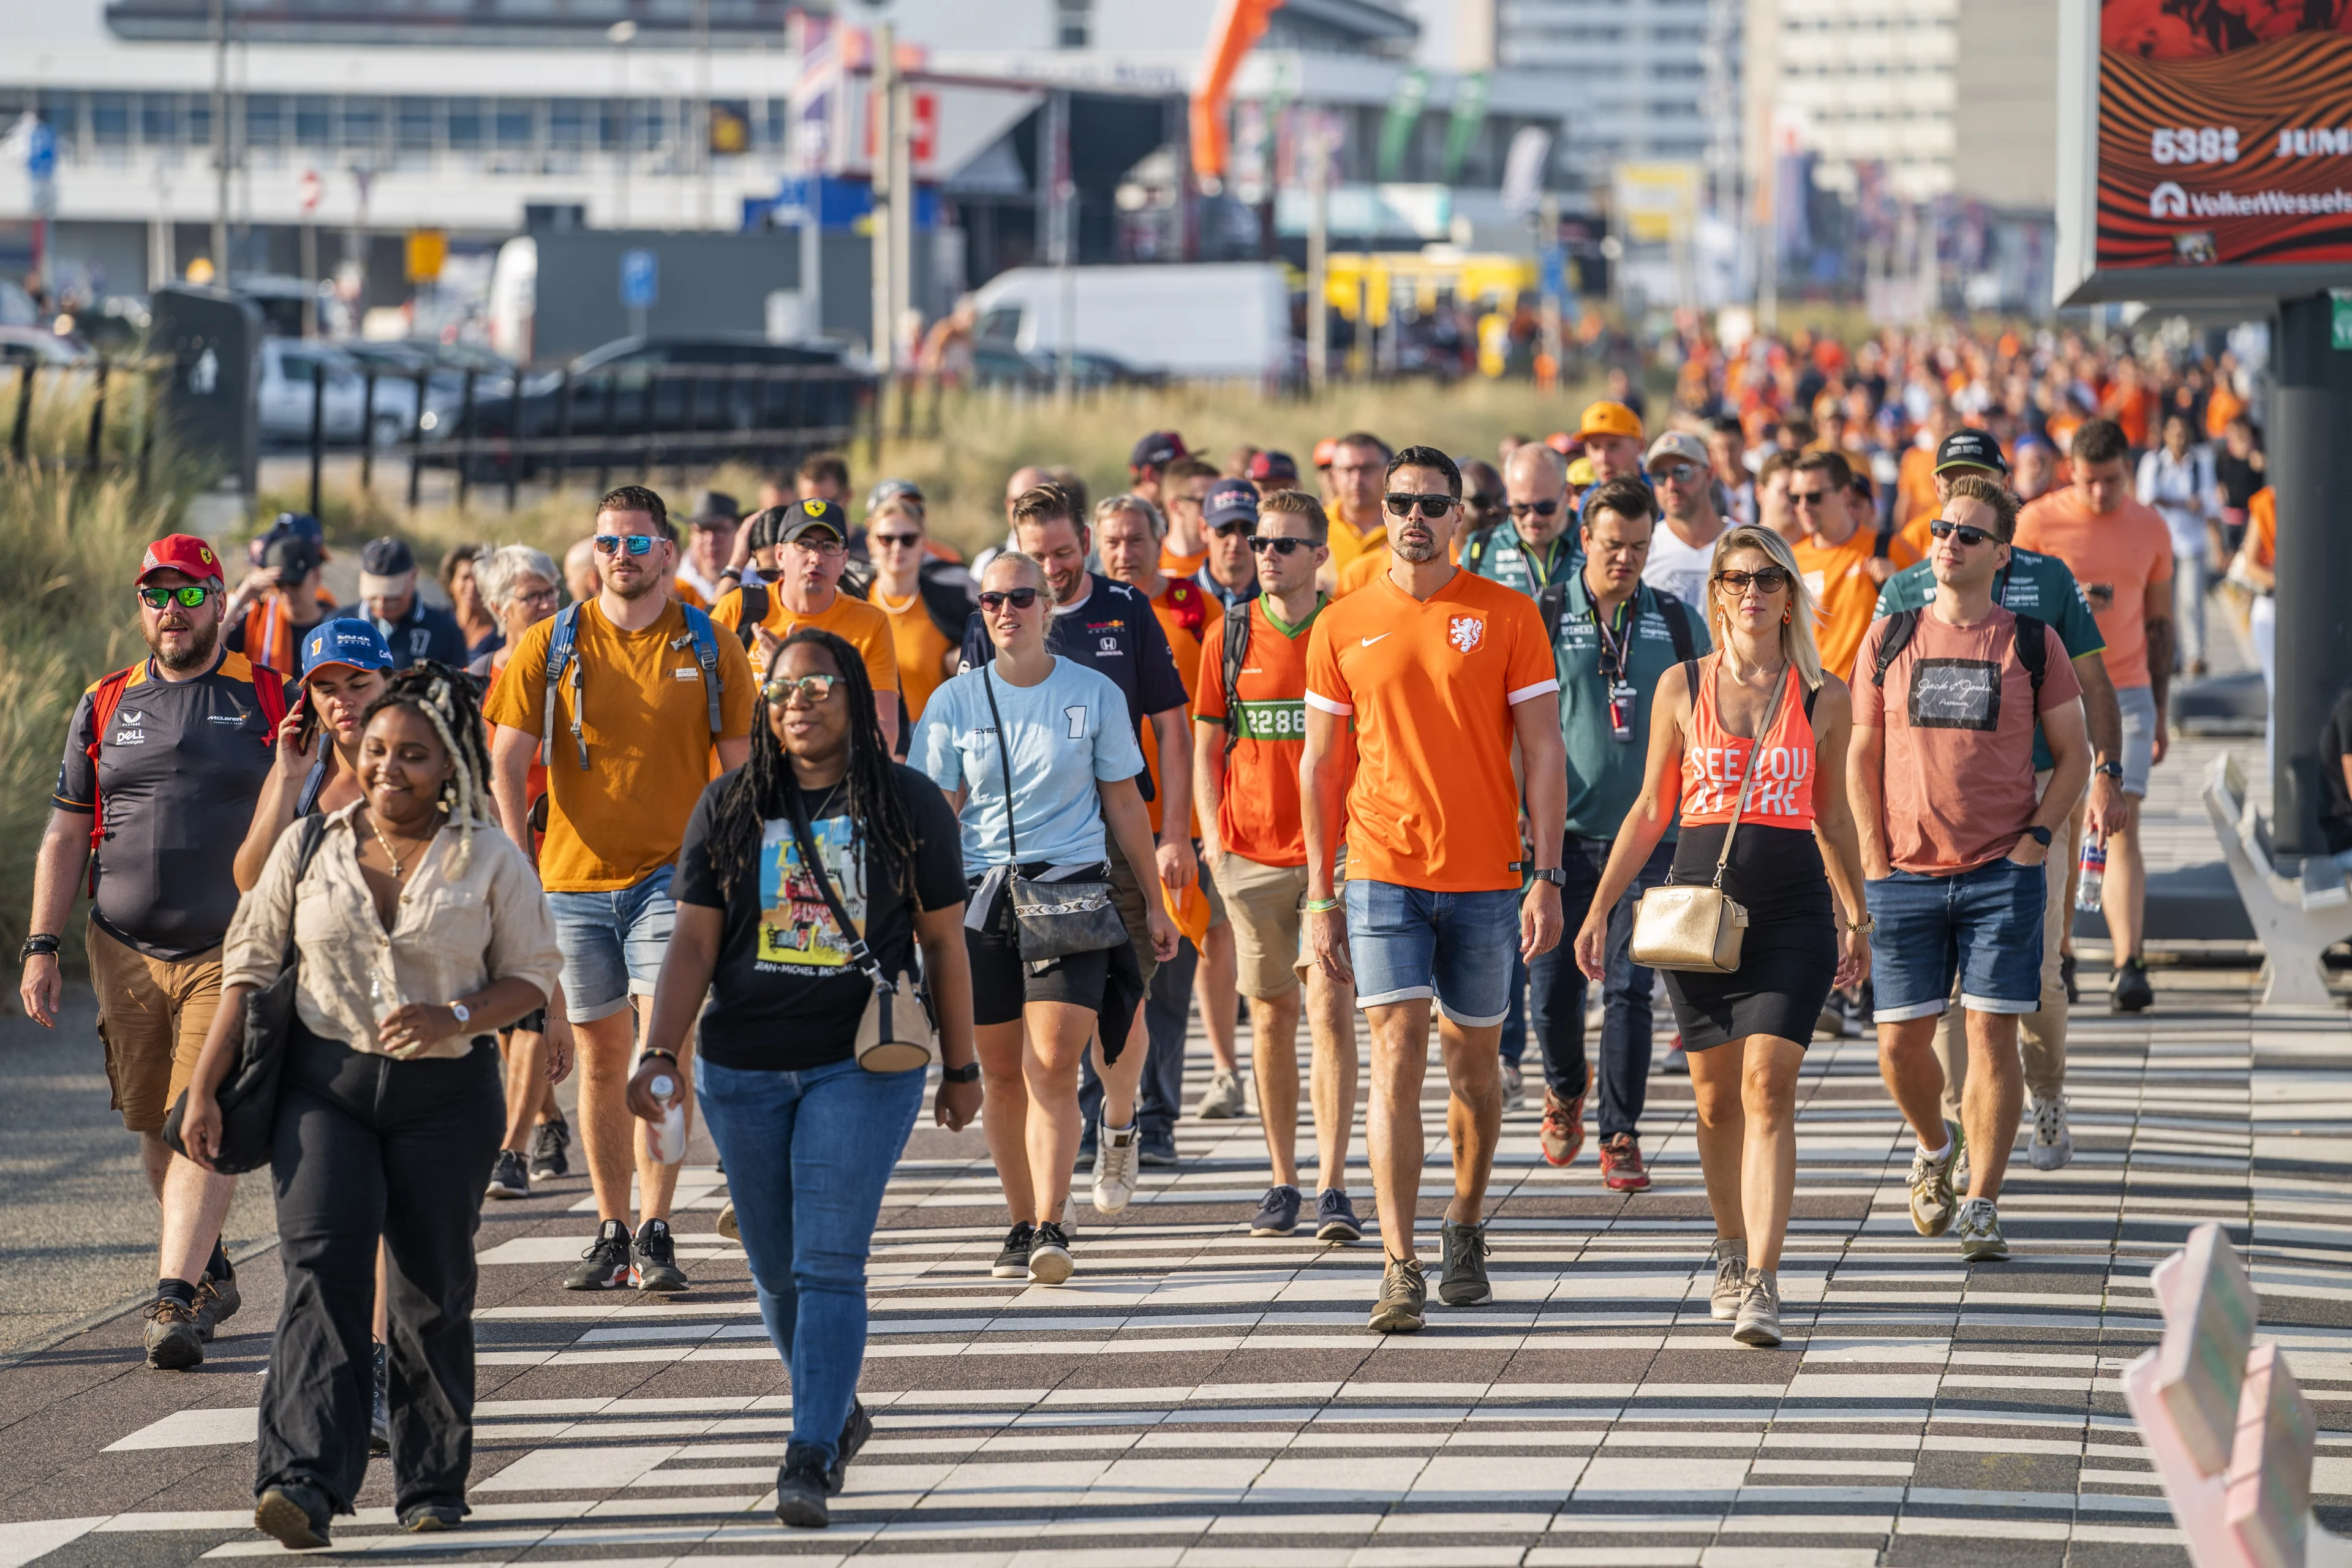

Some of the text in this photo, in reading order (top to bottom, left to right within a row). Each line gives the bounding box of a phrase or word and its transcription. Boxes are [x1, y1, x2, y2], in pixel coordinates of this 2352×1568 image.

[311, 638, 322, 657] 1
[1917, 678, 1949, 699] Jack
[1959, 679, 1992, 699] Jones
[117, 729, 145, 742] DELL
[1064, 705, 1087, 739] 1
[1691, 747, 1807, 782] SEE YOU
[1690, 780, 1803, 816] AT THE
